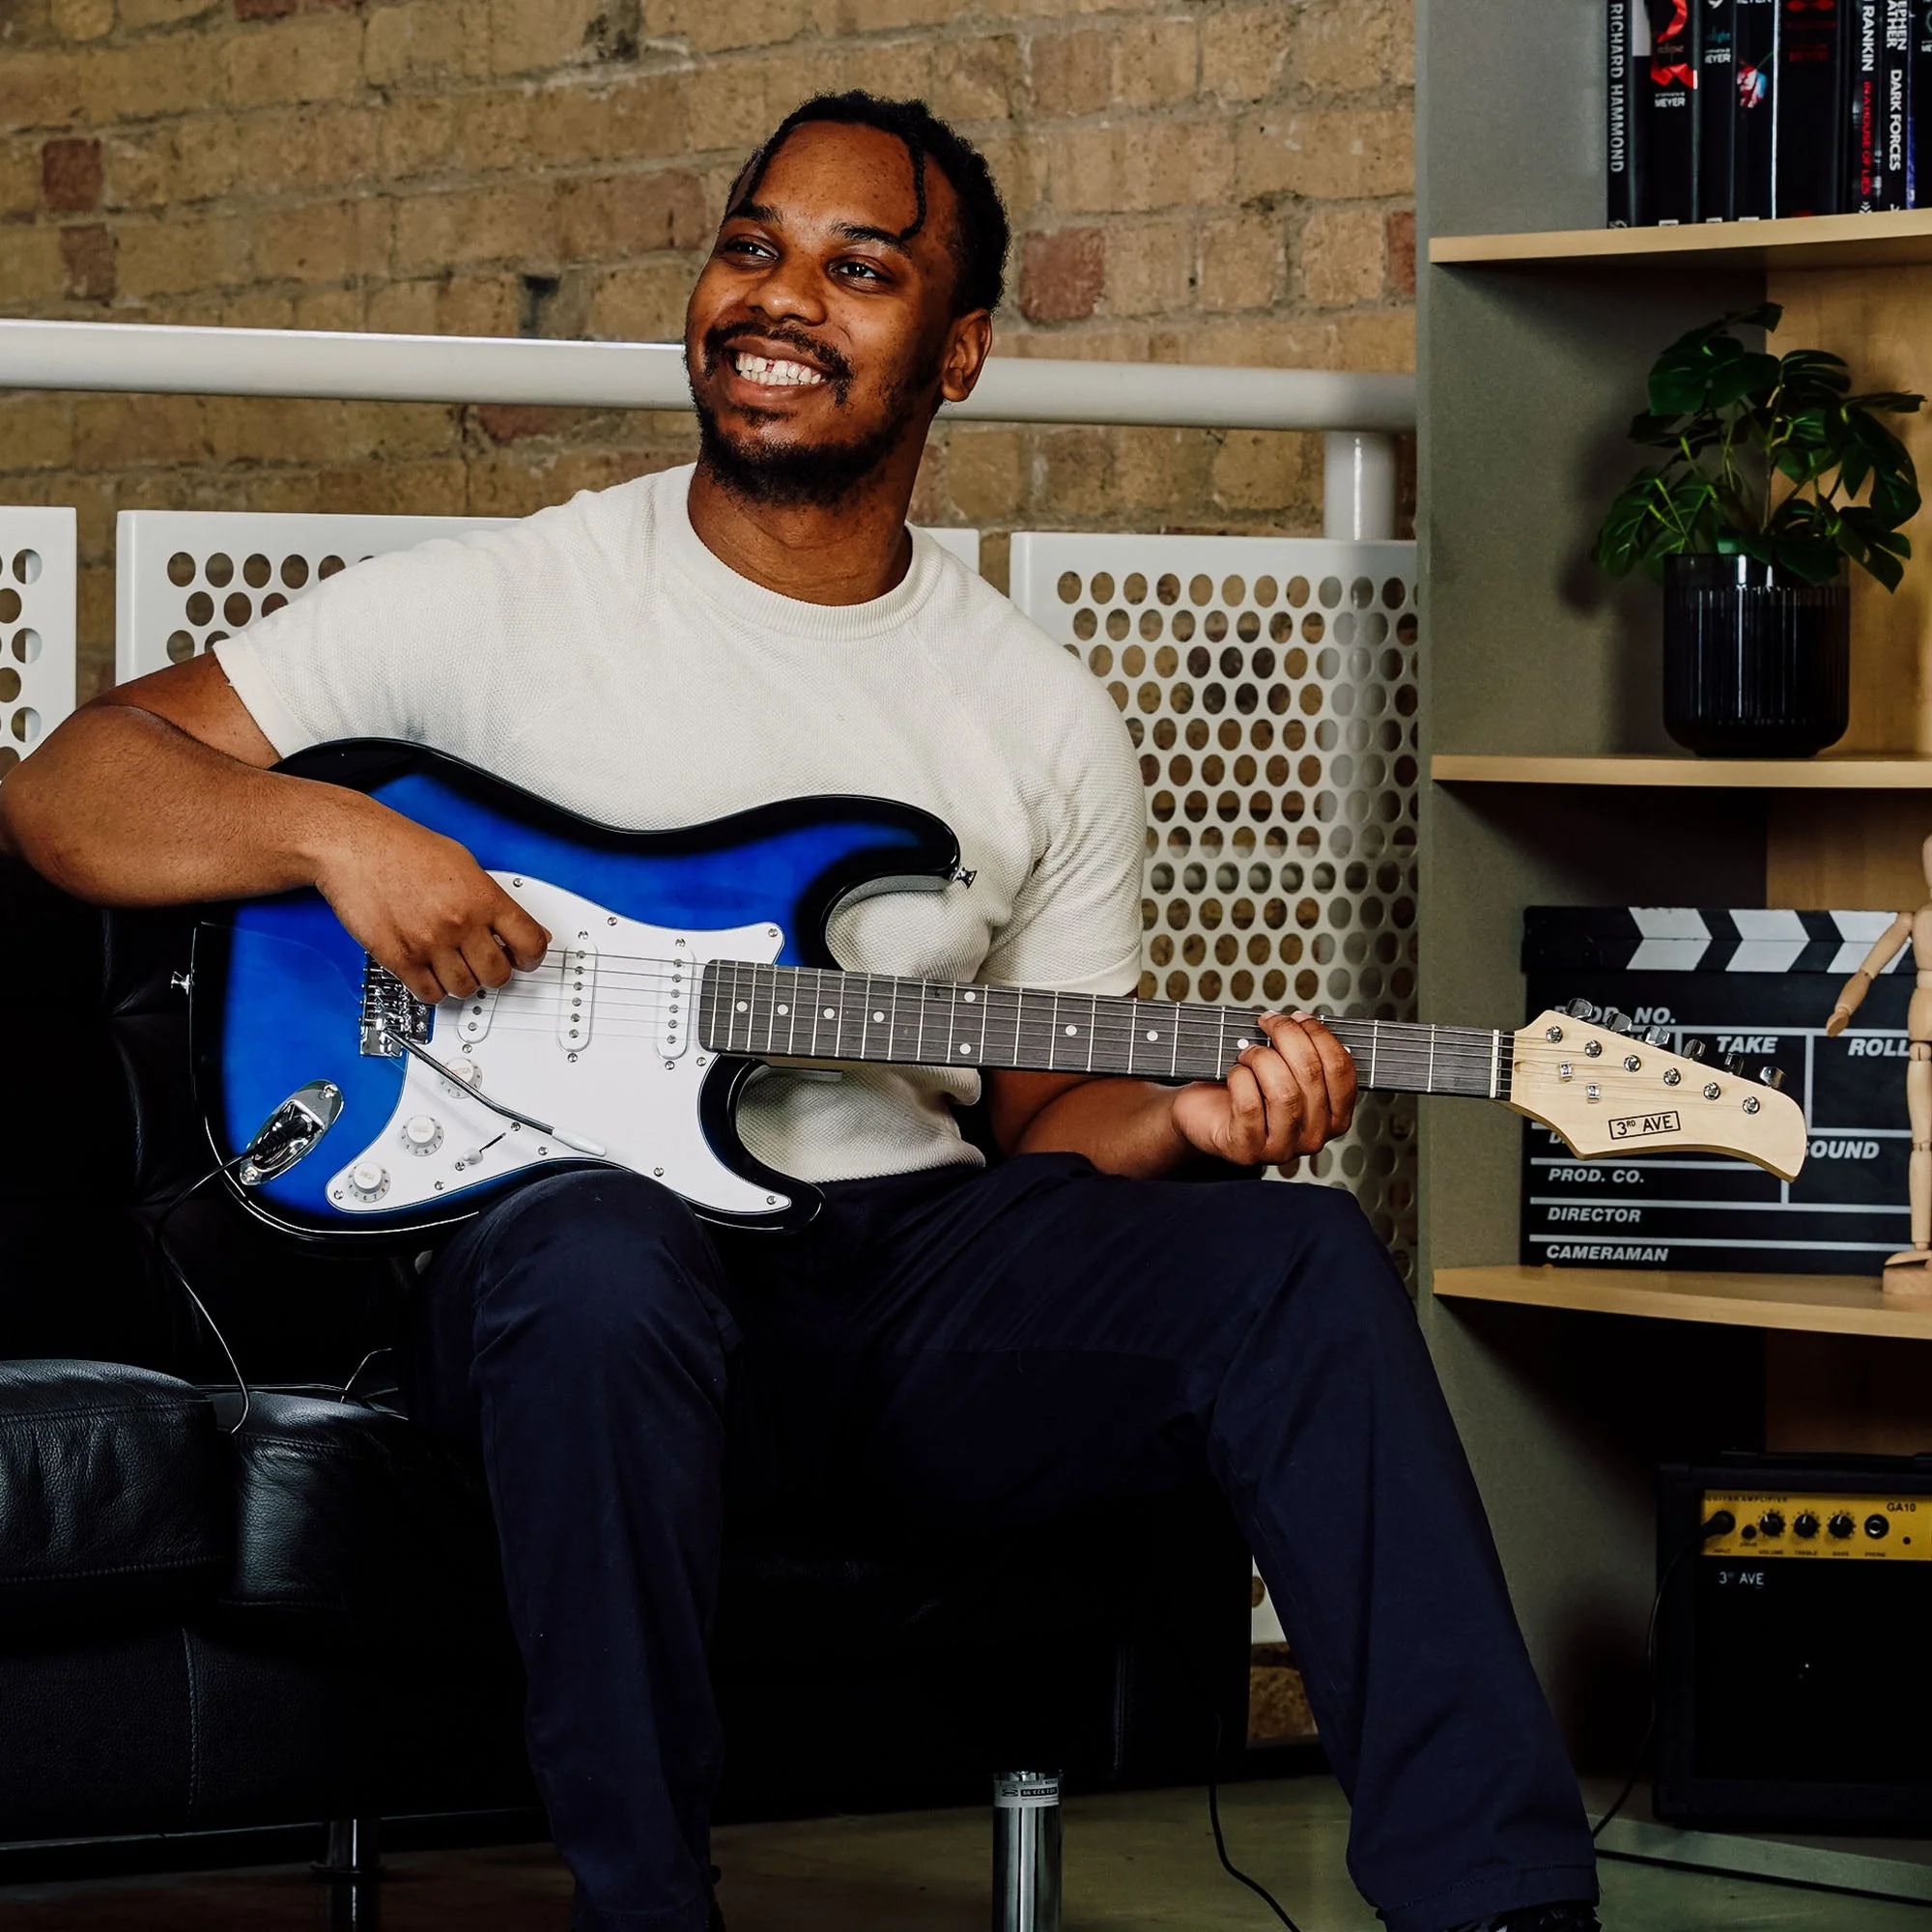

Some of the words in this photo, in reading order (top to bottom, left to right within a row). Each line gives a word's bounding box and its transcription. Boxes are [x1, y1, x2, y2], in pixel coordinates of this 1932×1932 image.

[1609, 3, 1624, 78] RICHARD
[1861, 5, 1875, 71] RANKIN
[1889, 70, 1903, 112] DARK
[1610, 84, 1625, 173] HAMMOND
[1889, 114, 1902, 171] FORCES
[1861, 150, 1871, 166] OF
[1634, 1007, 1676, 1024] NO.
[1717, 1036, 1778, 1053] TAKE
[1848, 1038, 1910, 1057] ROLL
[1616, 1119, 1636, 1136] 3RD
[1642, 1115, 1673, 1132] AVE
[1805, 1140, 1880, 1159] OUND
[1548, 1168, 1605, 1181] PROD.
[1612, 1169, 1645, 1183] CO.
[1547, 1207, 1642, 1223] DIRECTOR
[1547, 1244, 1669, 1262] CAMERAMAN
[1886, 1502, 1917, 1513] GA10
[1739, 1572, 1764, 1585] AVE
